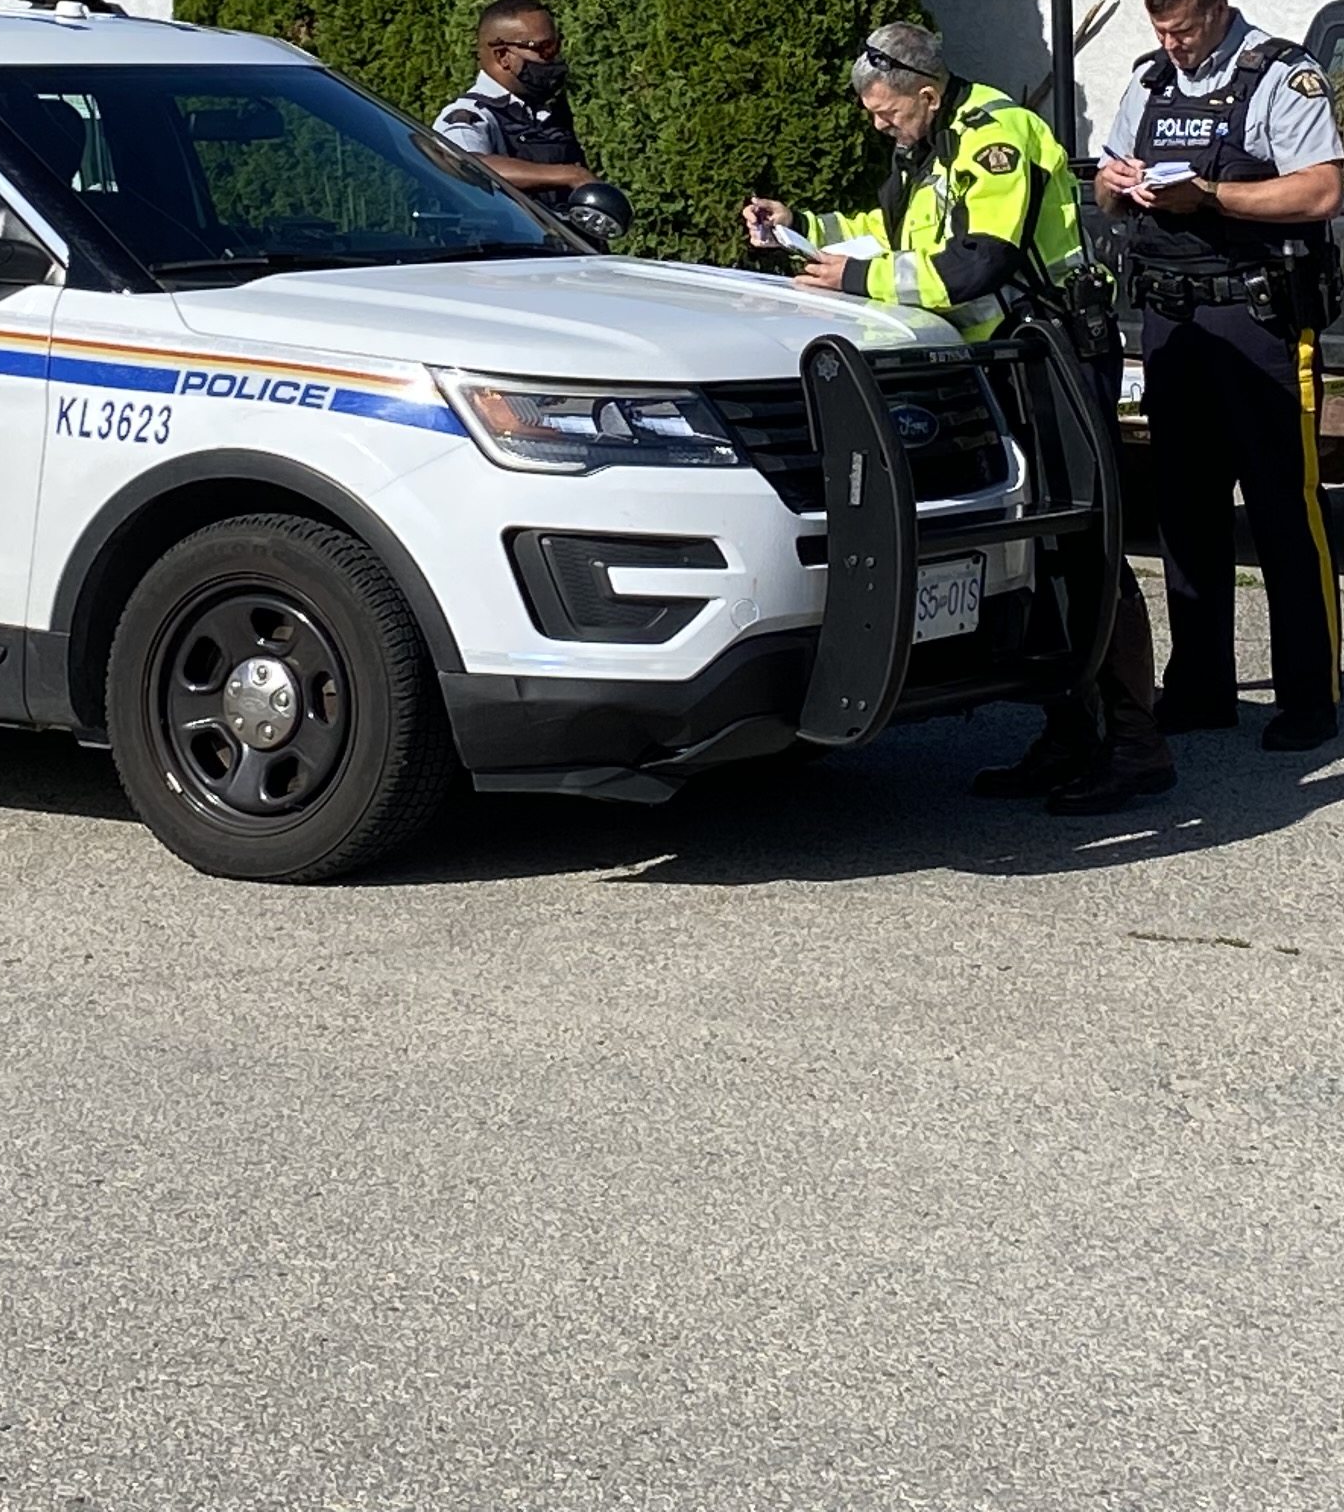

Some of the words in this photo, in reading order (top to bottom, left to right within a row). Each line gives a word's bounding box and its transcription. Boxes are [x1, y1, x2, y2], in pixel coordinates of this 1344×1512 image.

[1156, 118, 1214, 137] POLICE
[180, 371, 330, 409] POLICE
[56, 395, 172, 444] KL3623
